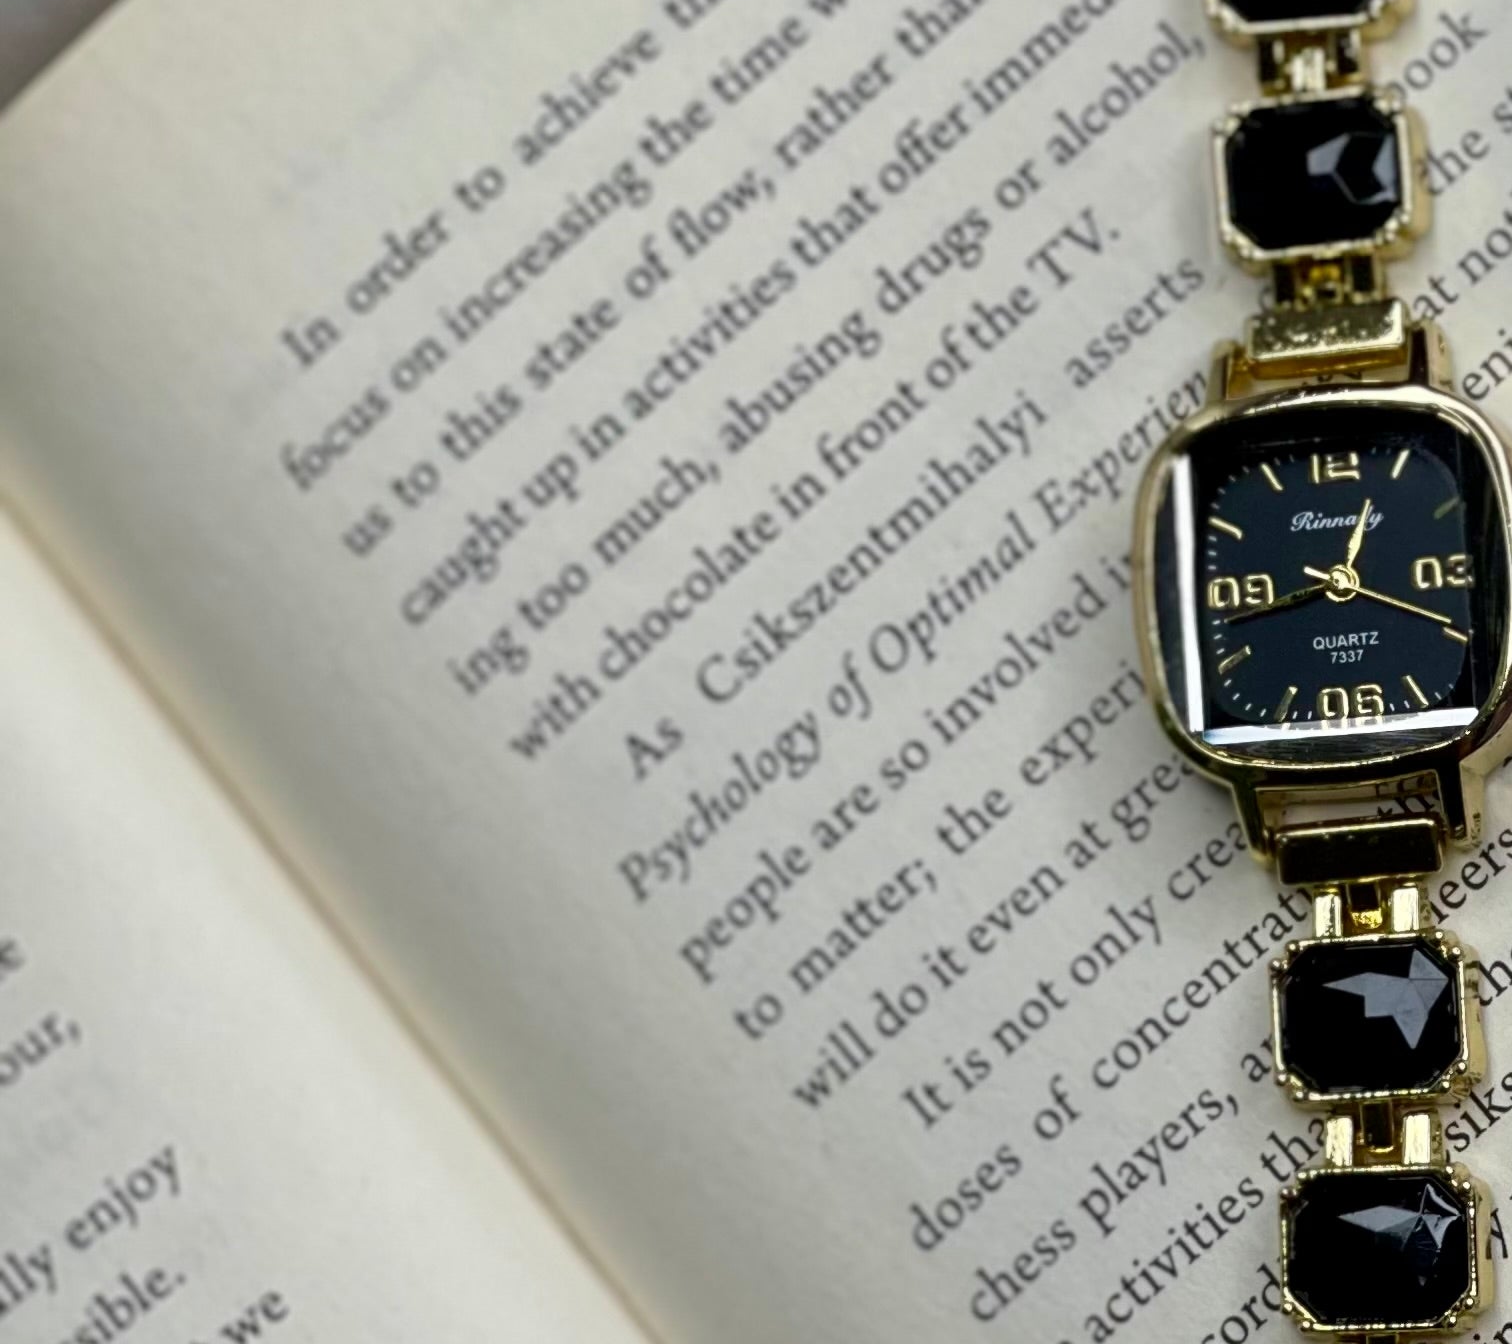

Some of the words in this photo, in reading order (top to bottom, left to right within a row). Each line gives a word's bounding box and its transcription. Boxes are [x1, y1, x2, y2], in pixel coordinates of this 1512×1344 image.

[280, 317, 341, 369] In
[346, 210, 450, 314] order
[453, 166, 506, 213] to
[514, 29, 661, 166] achieve
[625, 718, 684, 780] As
[696, 390, 1047, 703] Csikszentmihalyi
[1065, 254, 1206, 389] asserts
[1208, 573, 1275, 608] 09
[1411, 554, 1475, 590] 03
[1312, 630, 1381, 651] QUARTZ
[1330, 649, 1365, 665] 7337
[1317, 683, 1385, 719] 06
[64, 1146, 180, 1251] enjoy
[971, 1219, 1077, 1322] chess
[1079, 1089, 1239, 1237] players,
[1085, 1176, 1265, 1344] activities
